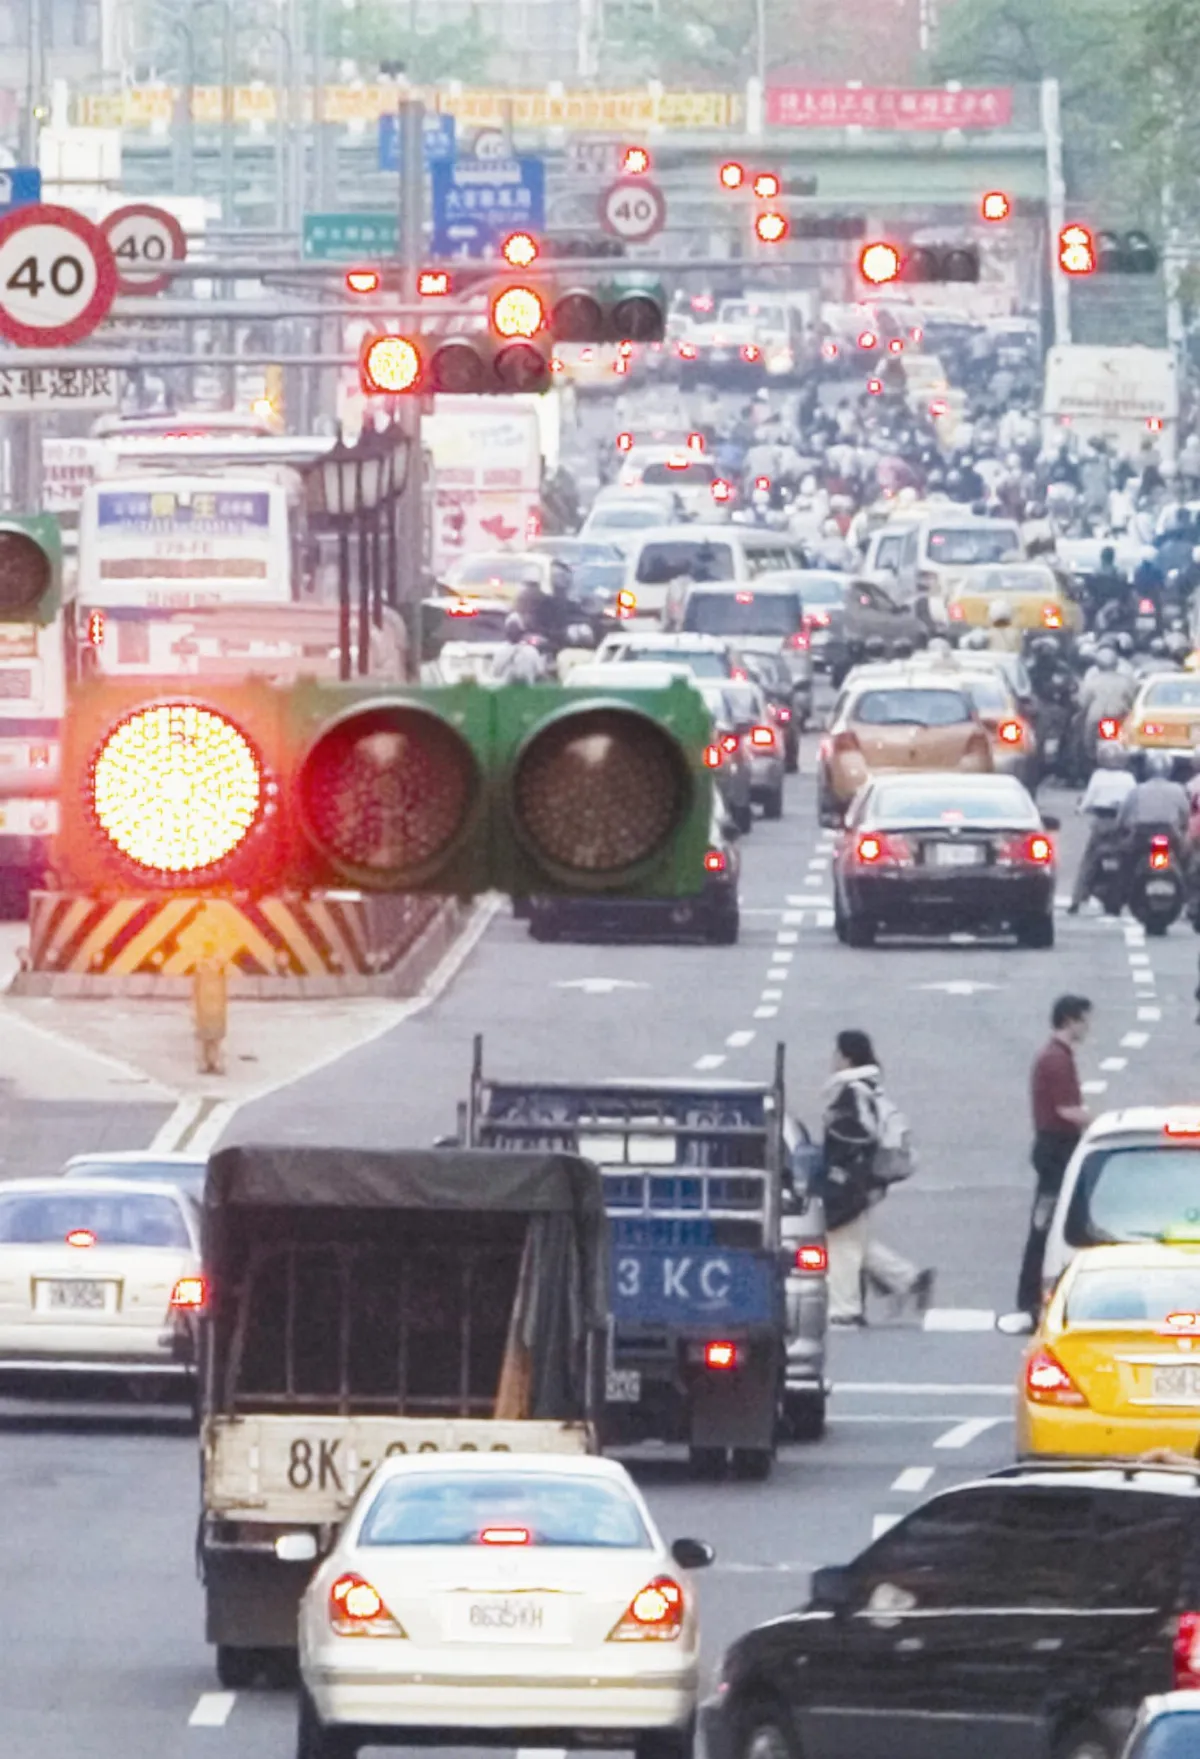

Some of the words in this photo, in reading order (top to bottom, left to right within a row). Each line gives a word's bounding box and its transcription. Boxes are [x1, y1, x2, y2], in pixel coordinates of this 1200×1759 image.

[614, 199, 652, 221] 40
[115, 234, 166, 262] 40
[6, 255, 84, 298] 40
[662, 1256, 732, 1299] KC
